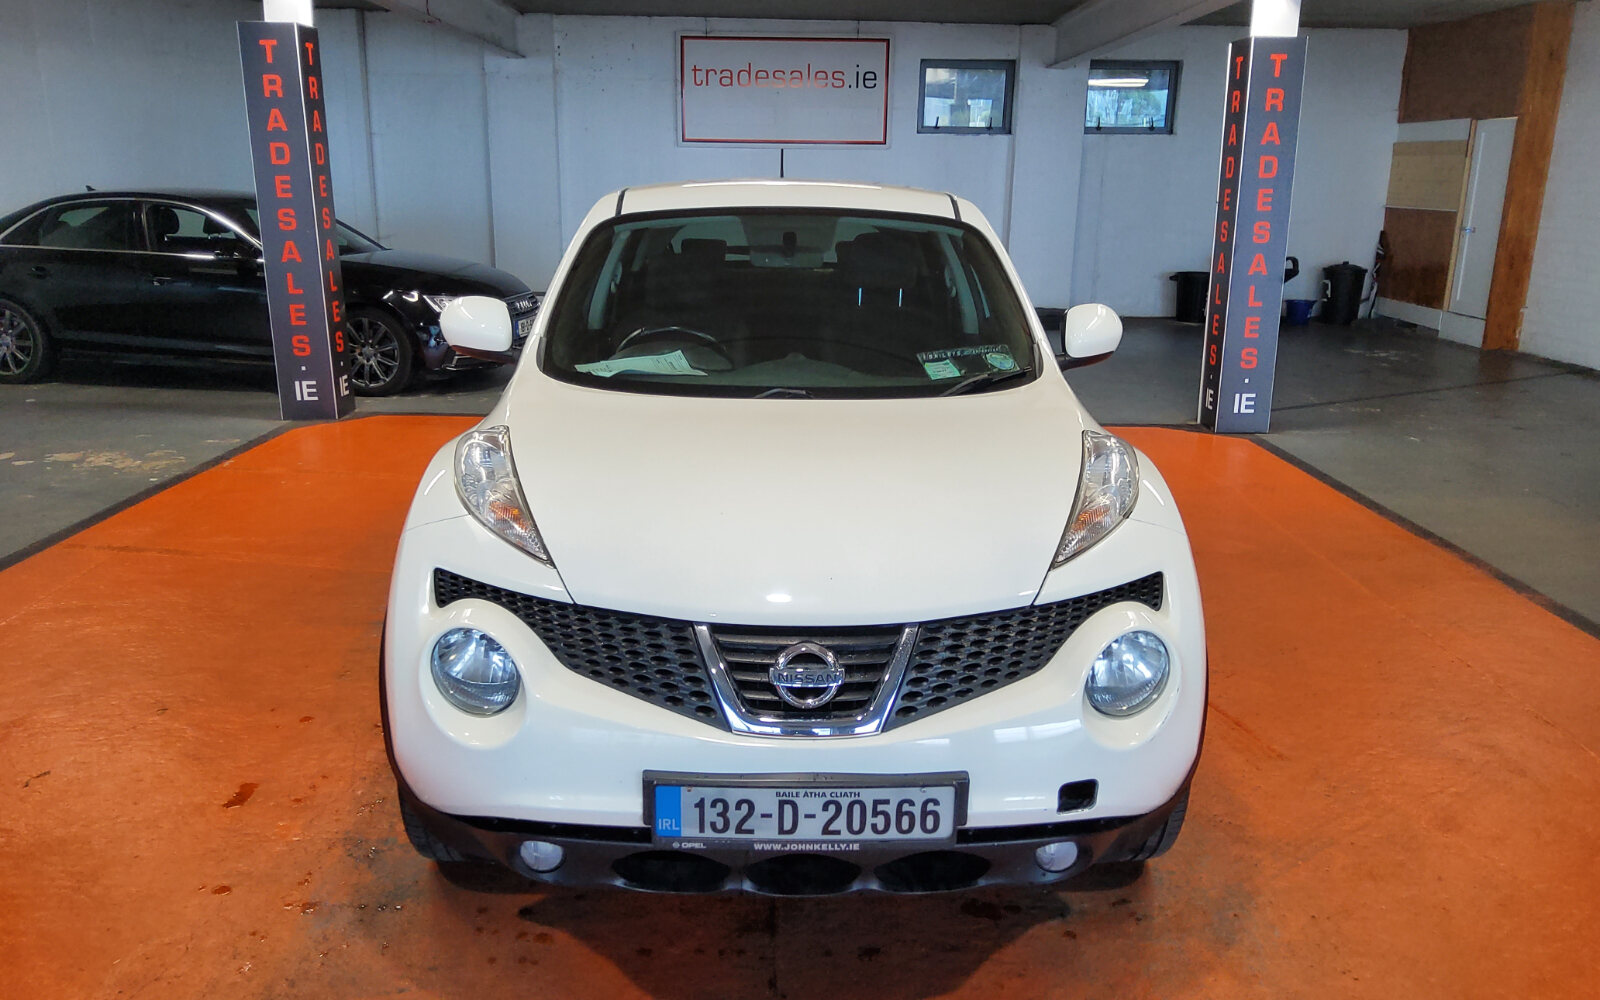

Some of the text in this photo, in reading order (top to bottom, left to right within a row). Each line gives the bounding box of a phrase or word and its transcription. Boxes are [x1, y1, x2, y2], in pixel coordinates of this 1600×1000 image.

[691, 62, 878, 89] tradesales.ie
[777, 672, 837, 684] NISSAN
[693, 797, 941, 836] 132-D-20566
[658, 819, 680, 831] IRL
[681, 841, 707, 849] OPEL
[753, 842, 860, 851] WWW.JOHNKELLY.IE
